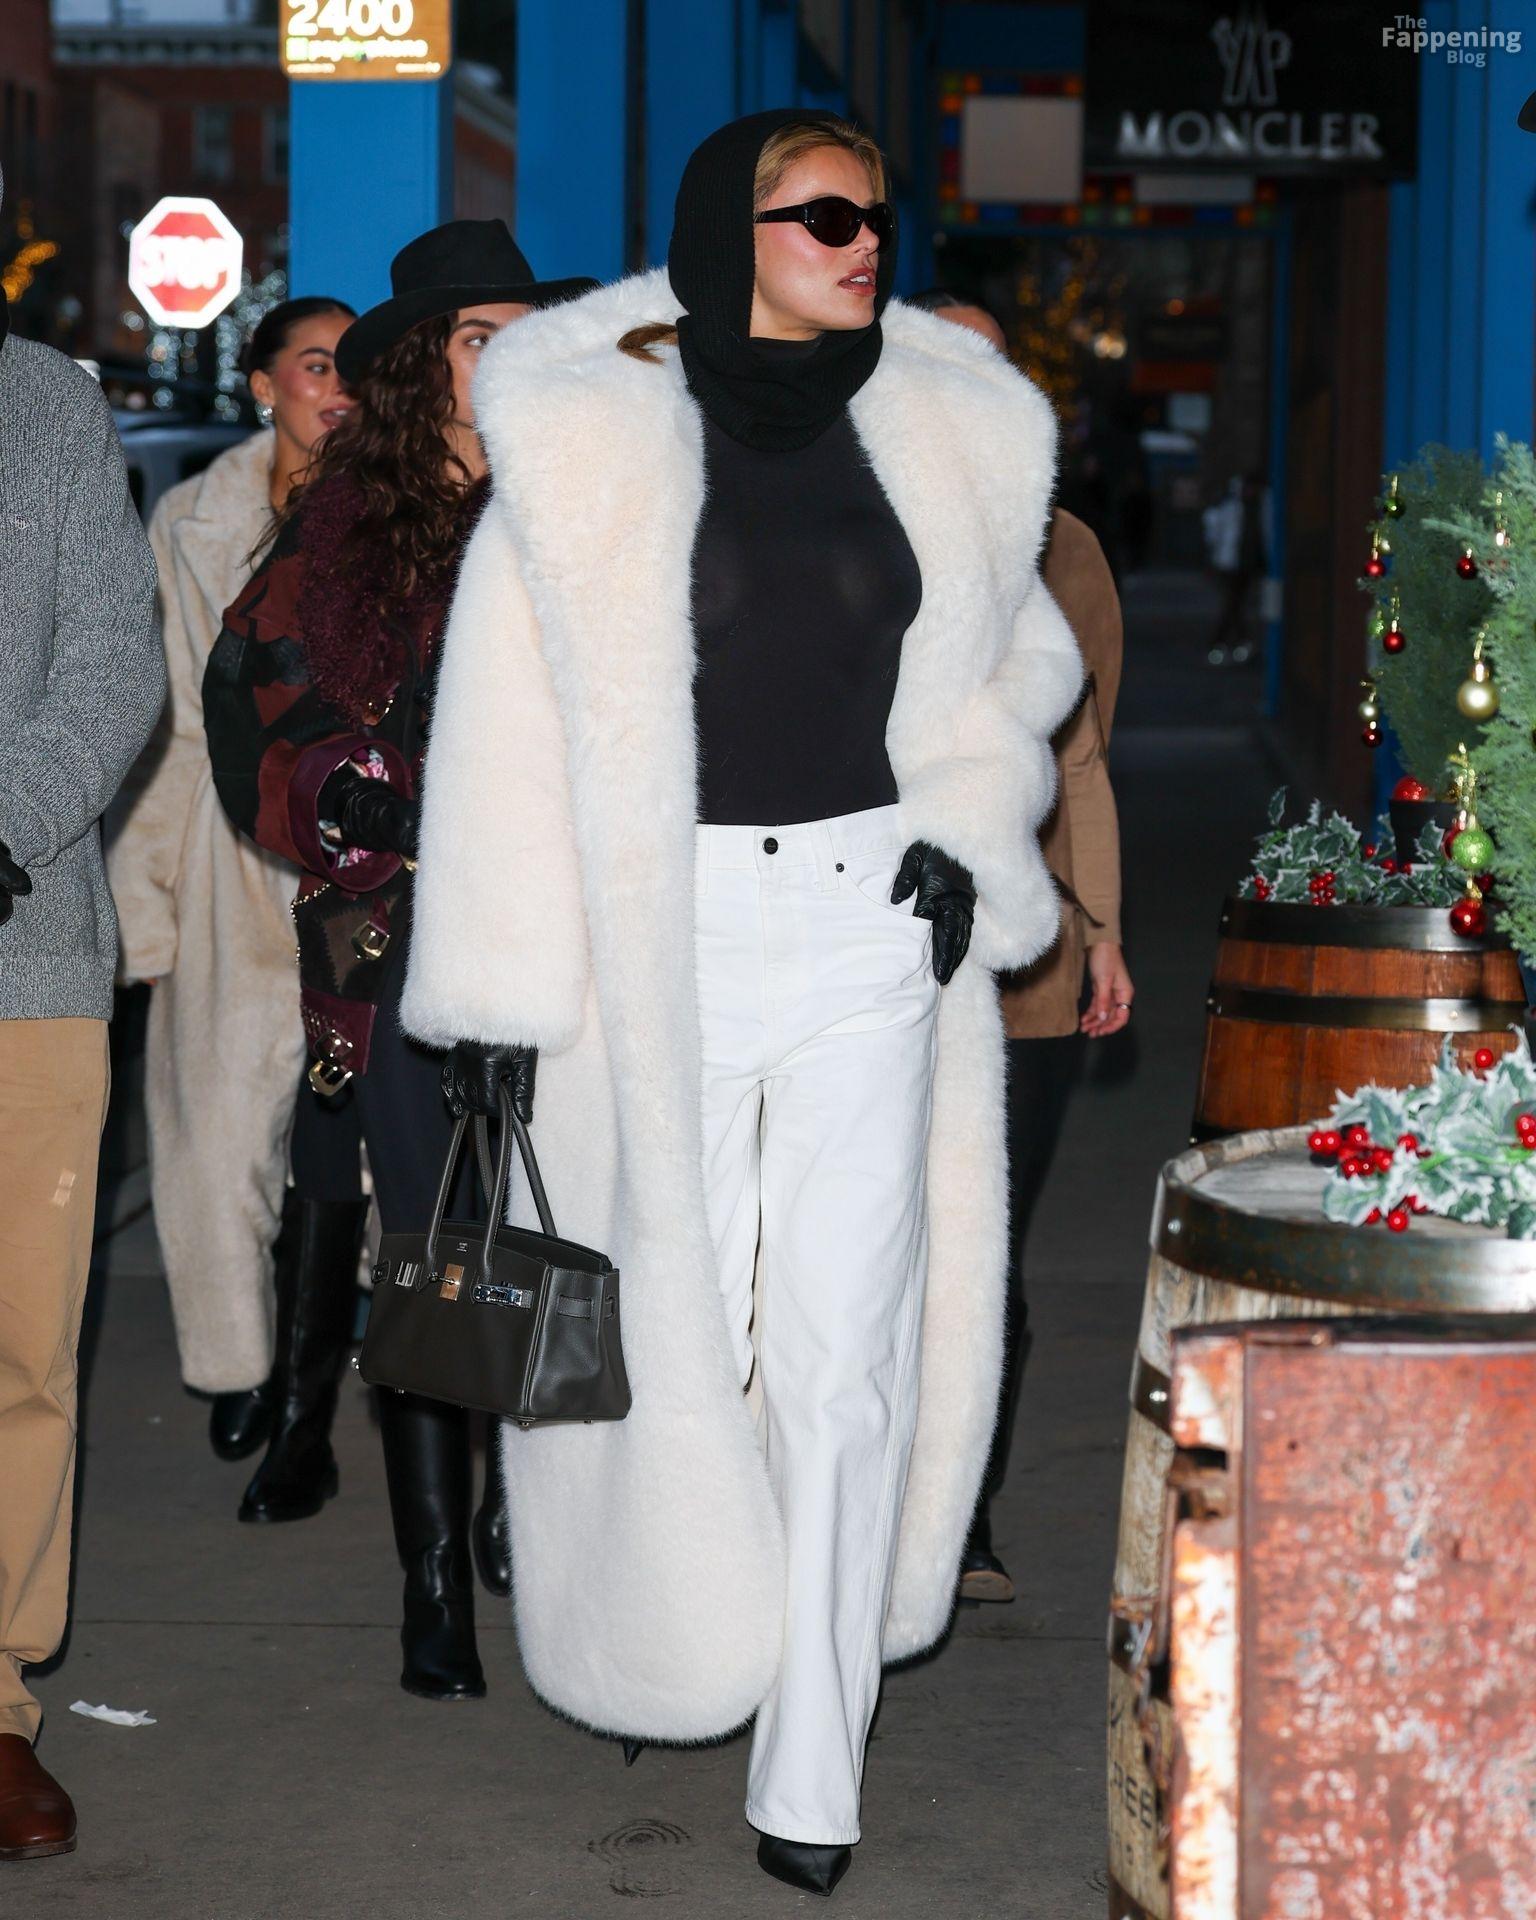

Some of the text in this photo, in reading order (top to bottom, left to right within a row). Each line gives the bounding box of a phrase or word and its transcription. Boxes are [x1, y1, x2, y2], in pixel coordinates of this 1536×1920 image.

[287, 0, 414, 37] 2400
[1117, 112, 1384, 160] MONCLER
[138, 234, 233, 290] STOP
